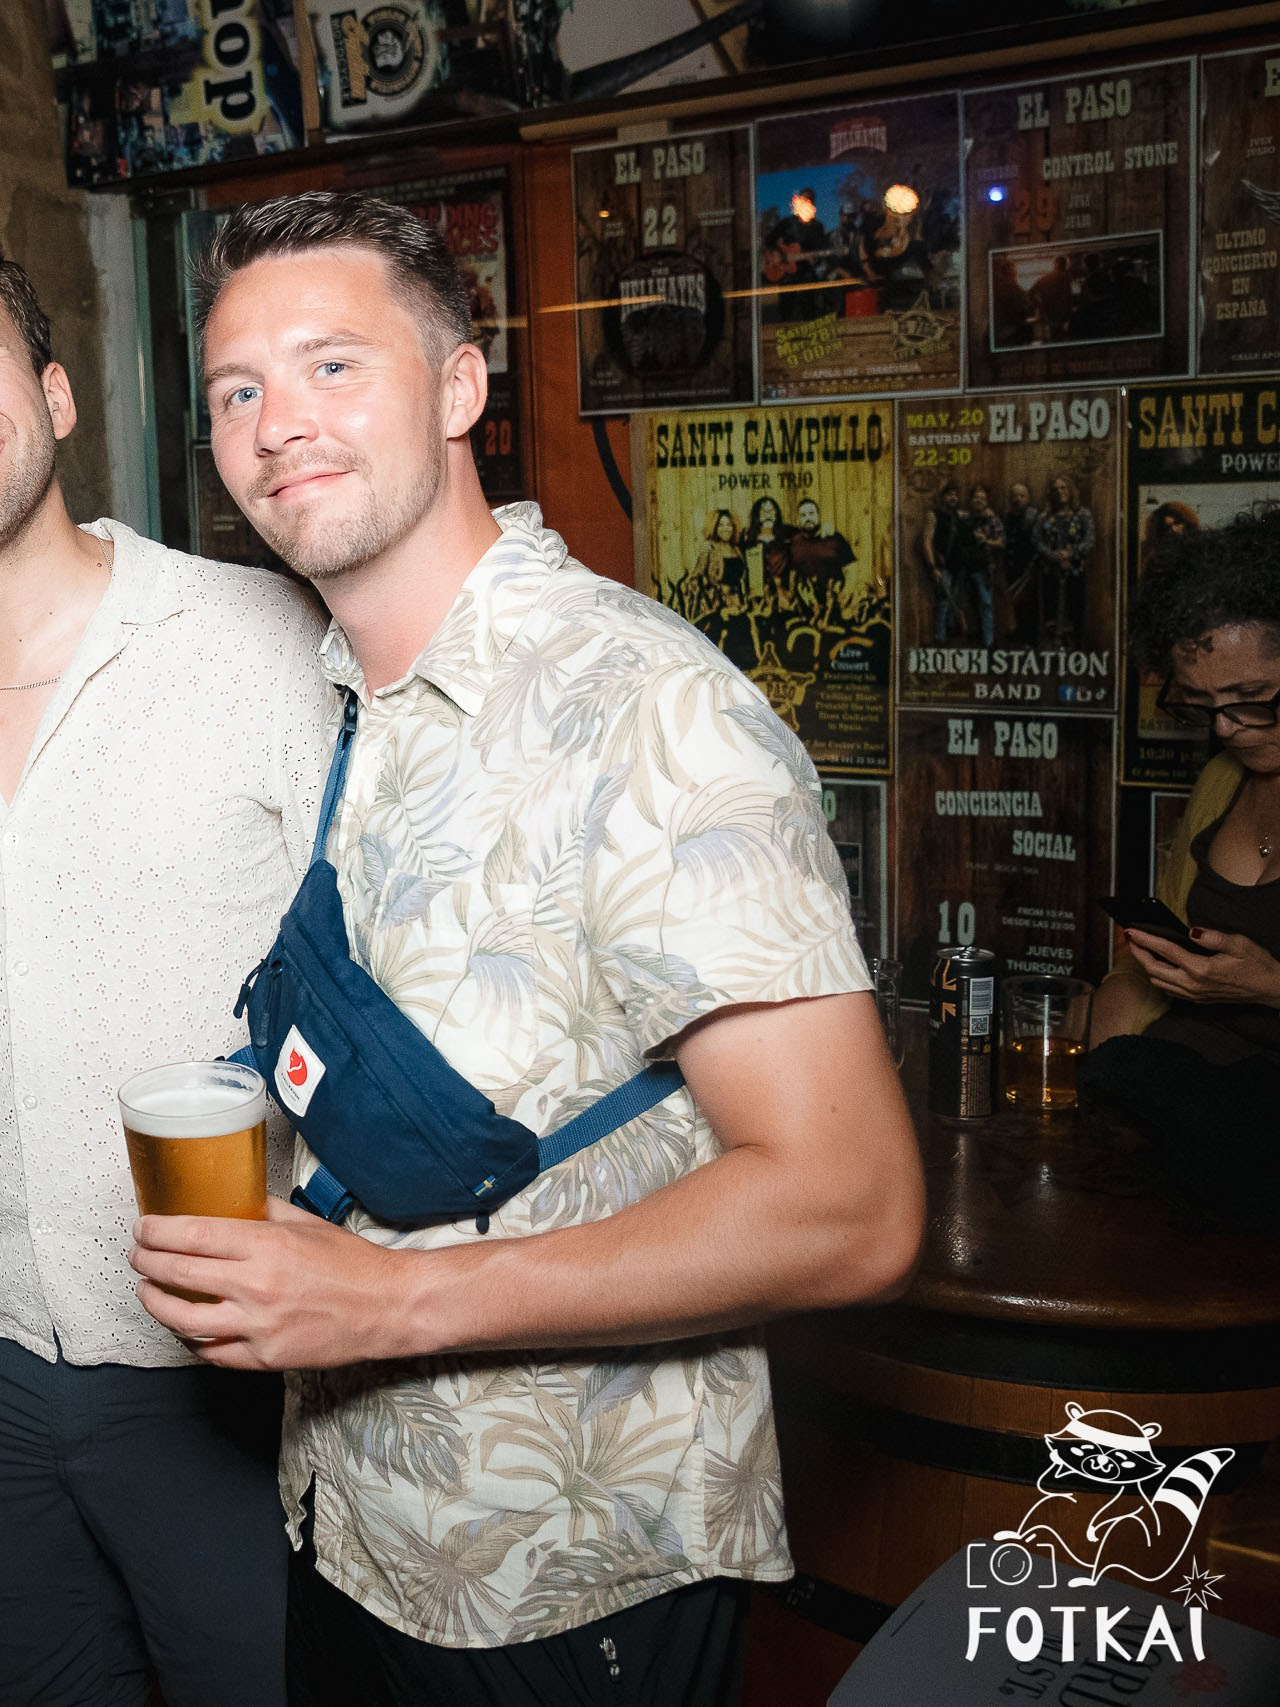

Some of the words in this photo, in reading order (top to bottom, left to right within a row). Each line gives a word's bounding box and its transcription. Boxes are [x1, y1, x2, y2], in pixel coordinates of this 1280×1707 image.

[1017, 91, 1050, 131] EL
[1065, 79, 1132, 124] PASO
[614, 151, 641, 185] EL
[652, 141, 706, 180] PASO
[1043, 151, 1115, 180] CONTROL
[1124, 142, 1178, 170] STONE
[643, 204, 678, 247] 22
[1204, 251, 1278, 273] CONCIERTO
[1232, 277, 1251, 297] EN
[1216, 299, 1268, 321] ESPAÑA
[958, 408, 985, 426] 20
[988, 404, 1023, 443] EL
[1028, 398, 1111, 441] PASO
[1138, 392, 1244, 449] SANTI
[485, 418, 512, 456] 20
[657, 421, 734, 468] SANTI
[745, 414, 883, 465] CAMPILLO
[908, 432, 981, 446] SATURDAY
[914, 448, 973, 467] 22-30
[719, 473, 770, 490] POWER
[776, 471, 813, 489] TRIO
[908, 647, 989, 675] ROCK
[991, 646, 1110, 678] STATION
[974, 683, 1041, 700] BAND
[947, 718, 980, 756] EL
[993, 721, 1058, 760] PASO
[935, 790, 1044, 818] CONCIENCIA
[1012, 829, 1076, 862] SOCIAL
[938, 900, 976, 946] 10
[1006, 959, 1074, 976] THURSDAY
[1025, 945, 1073, 960] JUEVES
